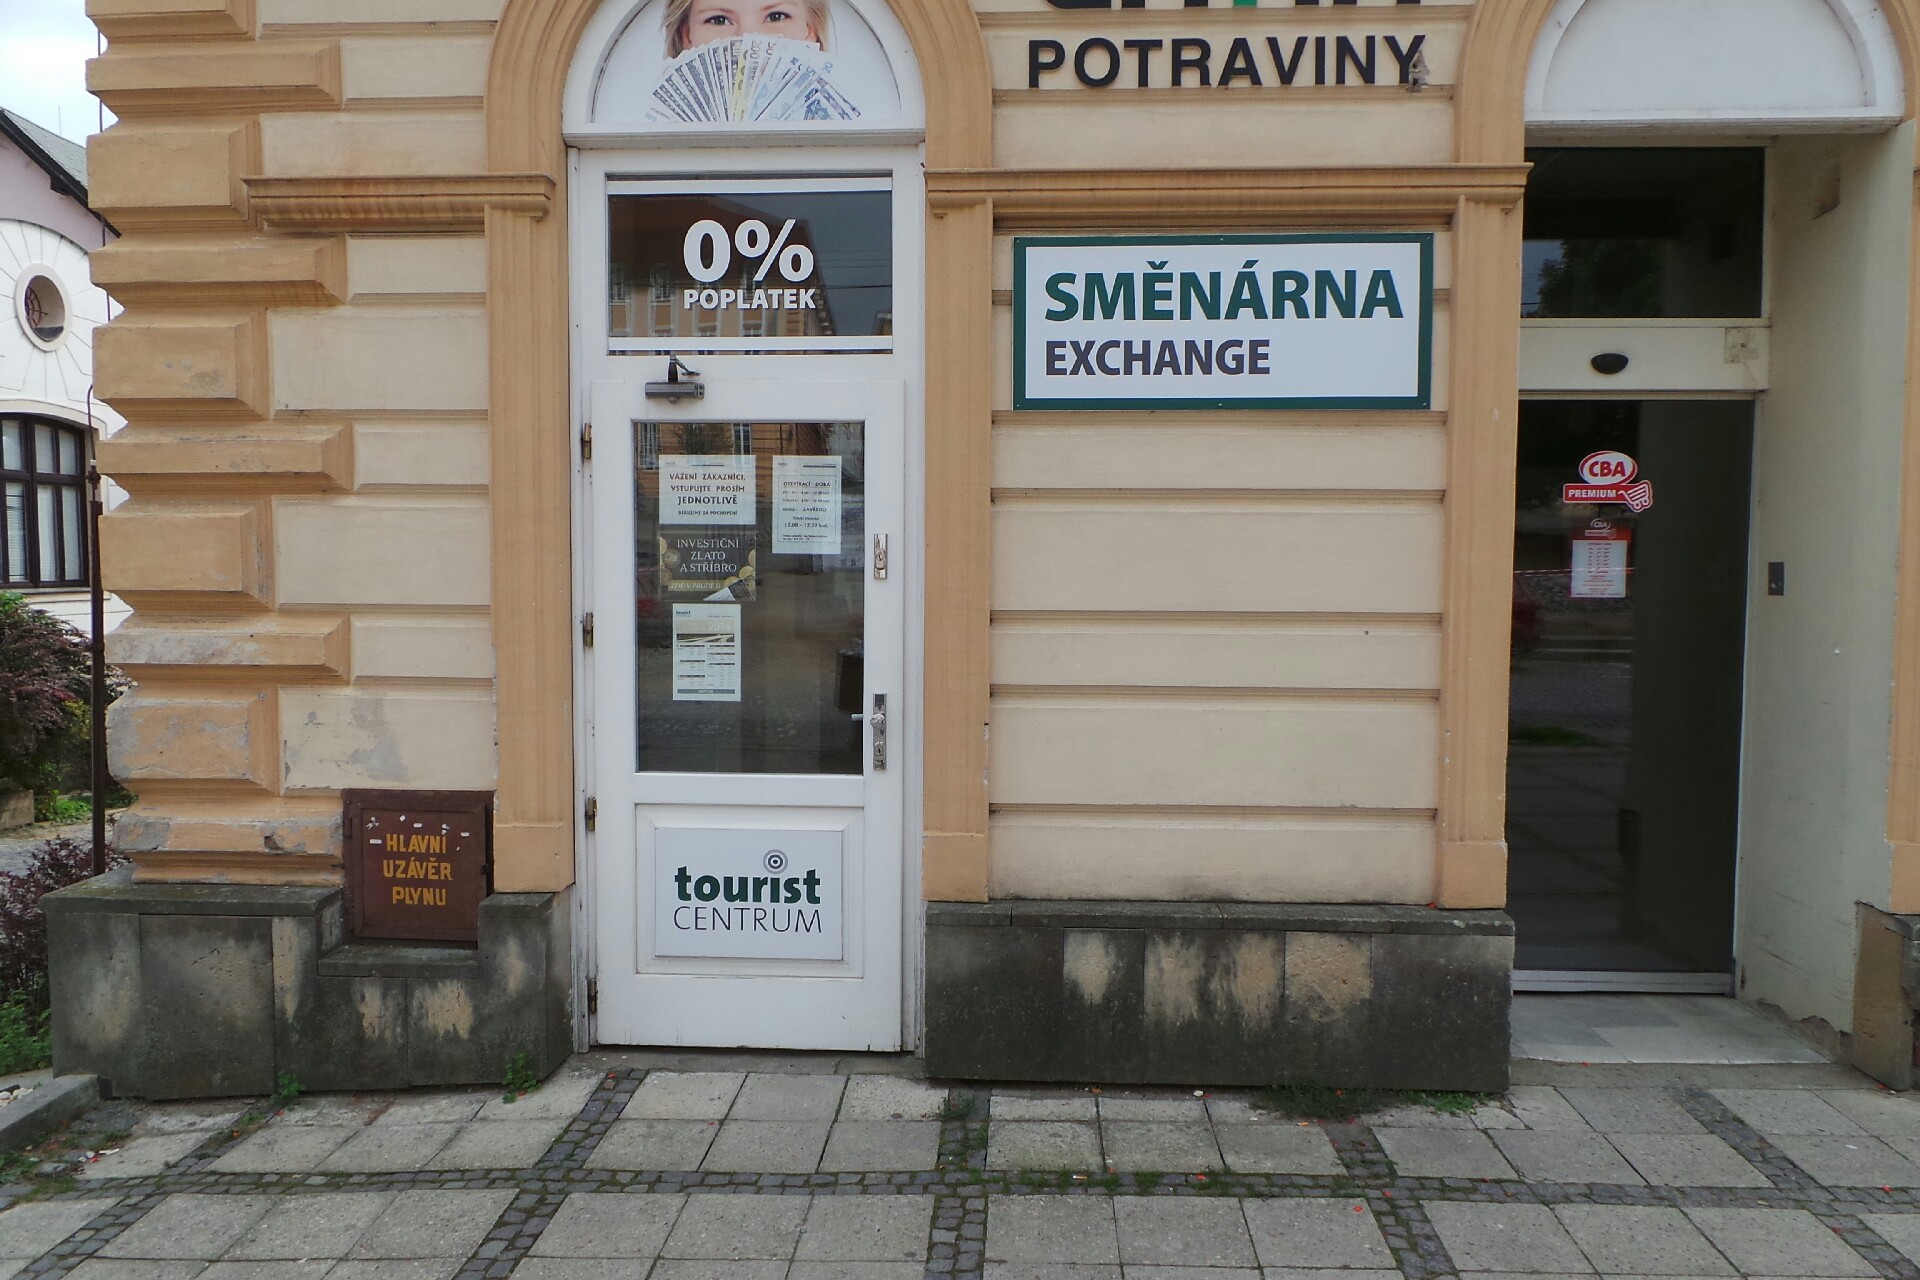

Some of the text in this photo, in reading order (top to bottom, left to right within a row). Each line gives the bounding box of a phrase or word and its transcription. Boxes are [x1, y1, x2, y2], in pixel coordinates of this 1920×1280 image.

[1028, 34, 1427, 90] POTRAVINY
[683, 218, 814, 283] 0%
[684, 288, 817, 309] POPLATEK
[1045, 259, 1404, 322] SMĚNÁRNA
[1045, 338, 1271, 376] EXCHANGE
[669, 472, 746, 482] VÁŽENÍ ZÁKAZNÍCI,
[1588, 460, 1626, 478] CBA
[671, 484, 745, 493] VSTUPUJTE PROSÍM
[1568, 489, 1617, 498] PREMIUM
[677, 494, 738, 506] JEDNOTLIVĚ
[677, 537, 739, 549] INVESTIČNÍ
[690, 551, 726, 560] ZLATO
[680, 561, 737, 573] A STŘÍBRO
[382, 856, 454, 881] UZÁVĚR
[674, 849, 821, 905] tourist
[391, 886, 447, 906] PLYNU
[673, 905, 822, 934] CENTRUM
